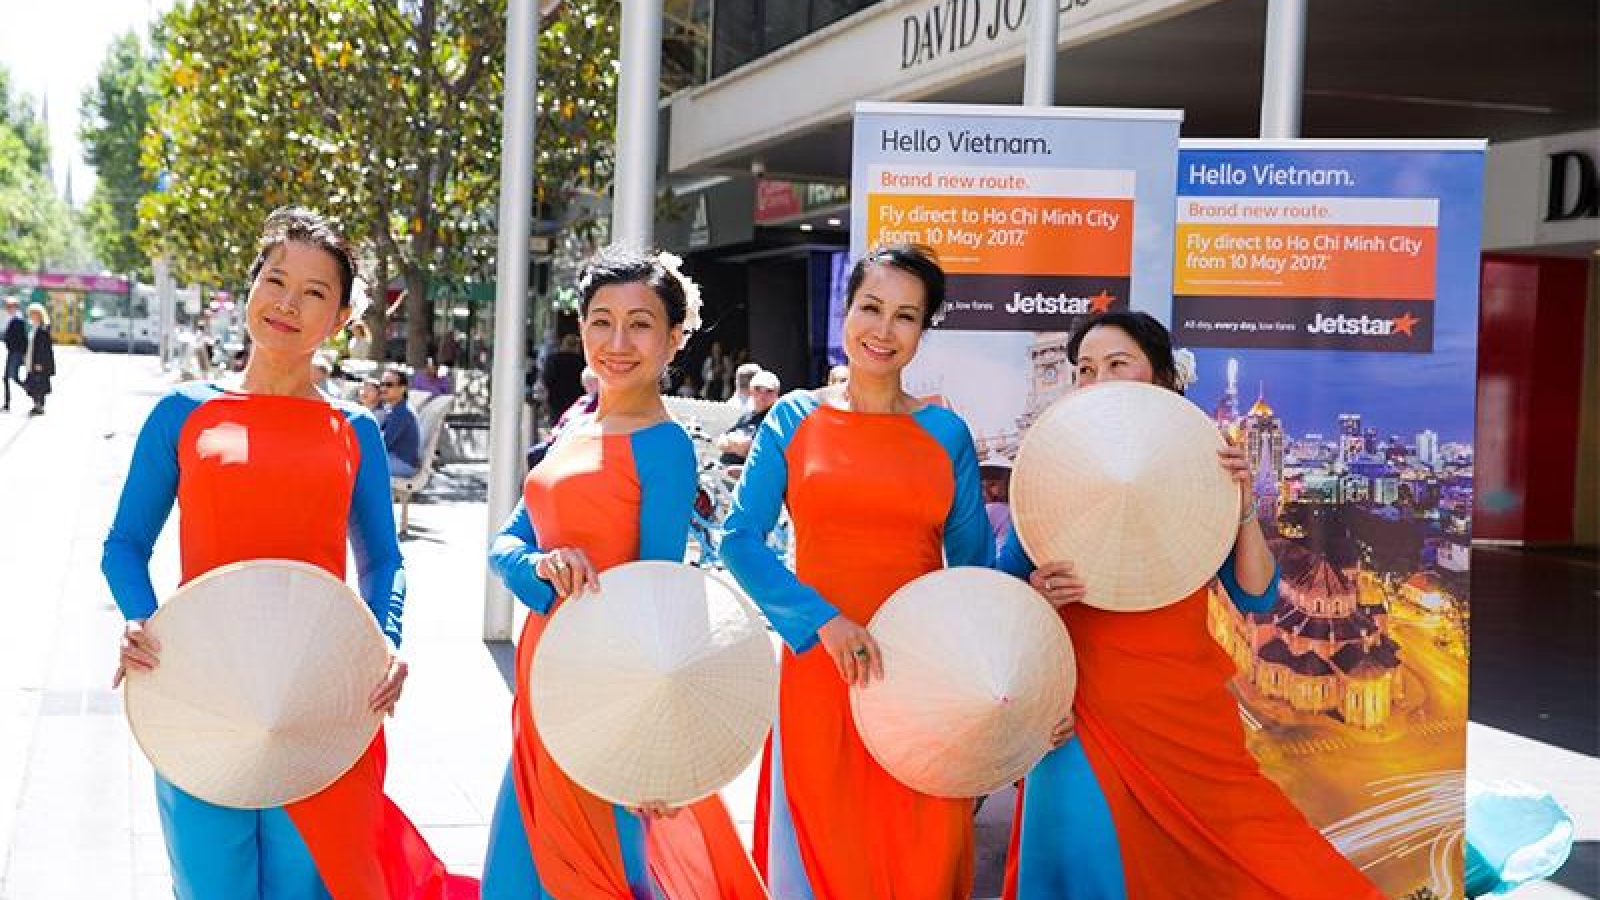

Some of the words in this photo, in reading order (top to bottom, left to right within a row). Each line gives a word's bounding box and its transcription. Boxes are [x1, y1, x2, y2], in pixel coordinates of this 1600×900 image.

[902, 0, 980, 70] DAVID
[881, 129, 941, 152] Hello
[948, 130, 1052, 154] Vietnam.
[881, 171, 932, 187] Brand
[938, 175, 974, 188] new
[980, 175, 1030, 189] route.
[1189, 163, 1247, 185] Hello
[1252, 163, 1355, 187] Vietnam.
[1543, 150, 1600, 223] D
[879, 205, 903, 227] Fly
[907, 205, 957, 224] direct
[961, 206, 979, 224] to
[983, 207, 1007, 225] Ho
[1011, 207, 1037, 226] Chi
[1041, 208, 1083, 227] Minh
[1086, 209, 1121, 231] City
[1189, 203, 1237, 217] Brand
[1243, 204, 1279, 217] new
[1284, 204, 1330, 218] route.
[879, 225, 921, 245] from
[926, 227, 943, 245] 10
[947, 228, 983, 249] May
[1187, 233, 1211, 253] Fly
[1213, 233, 1262, 250] direct
[1265, 235, 1283, 251] to
[1287, 235, 1311, 251] Ho
[1313, 235, 1340, 251] Chi
[1344, 235, 1385, 253] Minh
[1389, 235, 1423, 257] City
[1186, 252, 1226, 269] from
[1229, 253, 1248, 270] 10
[1251, 254, 1286, 275] May
[1005, 291, 1091, 314] Jetstar
[1306, 313, 1395, 336] Jetstar
